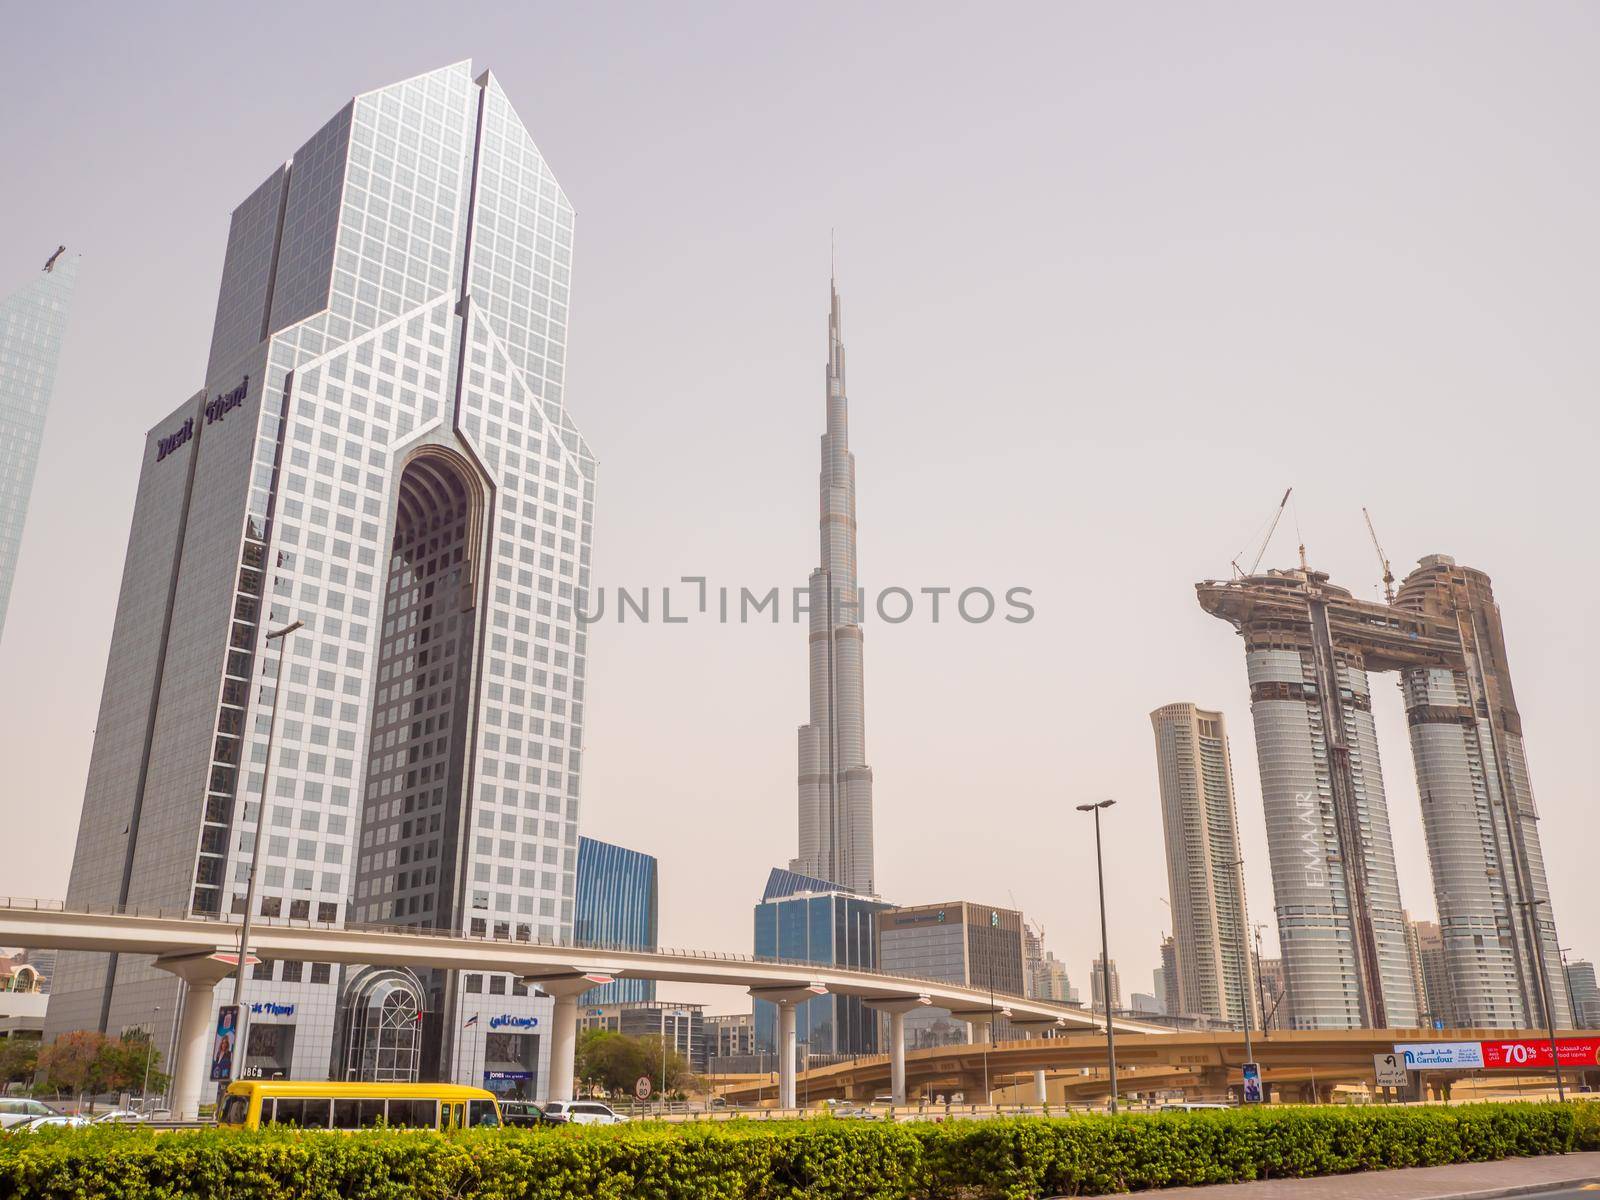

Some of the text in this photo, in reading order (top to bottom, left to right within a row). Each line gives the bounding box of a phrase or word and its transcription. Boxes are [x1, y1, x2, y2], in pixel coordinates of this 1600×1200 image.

[156, 374, 250, 462] Dusit Thani
[1295, 791, 1324, 887] EMAAR
[264, 1002, 294, 1016] Thani
[1501, 1044, 1537, 1063] 70%
[639, 1088, 648, 1096] 80
